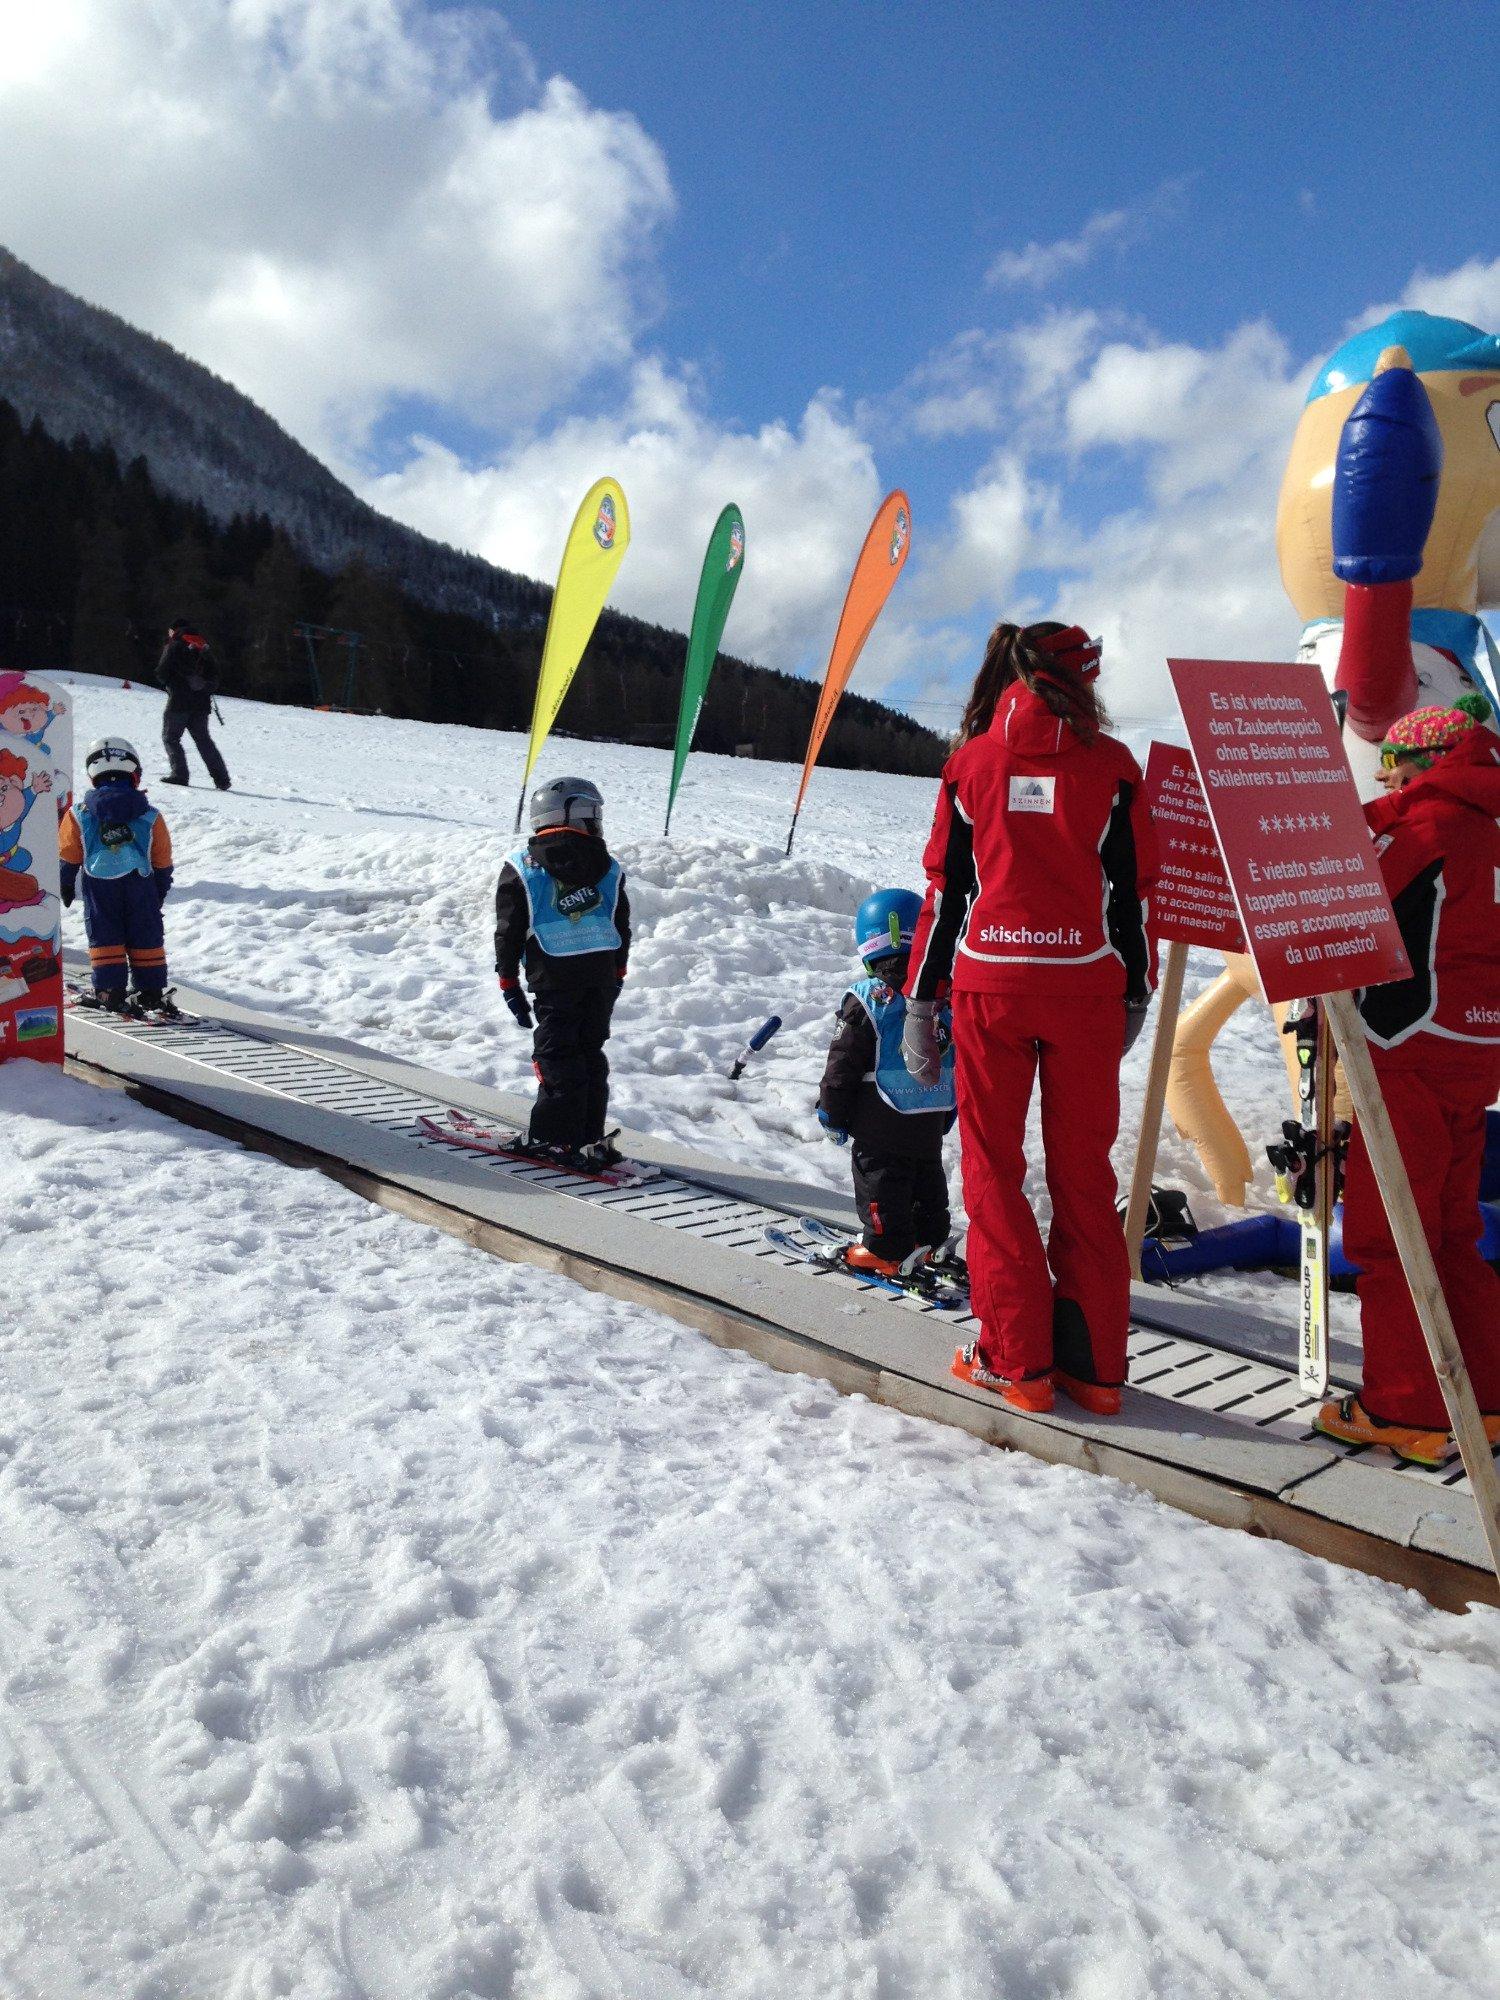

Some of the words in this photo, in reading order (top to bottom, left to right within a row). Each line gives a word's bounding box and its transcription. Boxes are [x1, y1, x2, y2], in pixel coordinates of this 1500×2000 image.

[1210, 692, 1229, 710] Es
[1230, 692, 1249, 710] ist
[1250, 693, 1307, 713] verboten,
[1209, 718, 1235, 735] den
[1235, 717, 1322, 738] Zauberteppich
[1216, 742, 1249, 761] ohne
[1249, 742, 1297, 760] Beisein
[1298, 742, 1330, 759] eines
[1172, 764, 1184, 778] Es
[1209, 769, 1274, 787] Skilehrers
[1274, 771, 1290, 785] zu
[1291, 766, 1349, 784] benutzen!
[1161, 779, 1180, 791] den
[1159, 793, 1183, 807] ohne
[1186, 798, 1209, 813] Beis
[1151, 805, 1195, 825] kilehrers
[1197, 818, 1210, 828] zu
[1195, 871, 1223, 885] salire
[1247, 858, 1262, 882] È
[1262, 860, 1307, 880] vietato
[1309, 856, 1344, 876] salire
[1345, 853, 1365, 872] col
[1177, 884, 1215, 899] magico
[1245, 890, 1298, 915] tappeto
[1299, 883, 1345, 907] magico
[1346, 882, 1382, 899] senza
[1164, 912, 1178, 922] un
[1180, 915, 1226, 932] maestro!
[1255, 920, 1300, 940] essere
[1301, 906, 1390, 933] accompagnato
[979, 925, 1082, 945] skischool.it
[1286, 945, 1304, 965] da
[1304, 945, 1323, 962] un
[1324, 932, 1378, 958] maestro!
[1304, 1265, 1312, 1360] WORLDCUP
